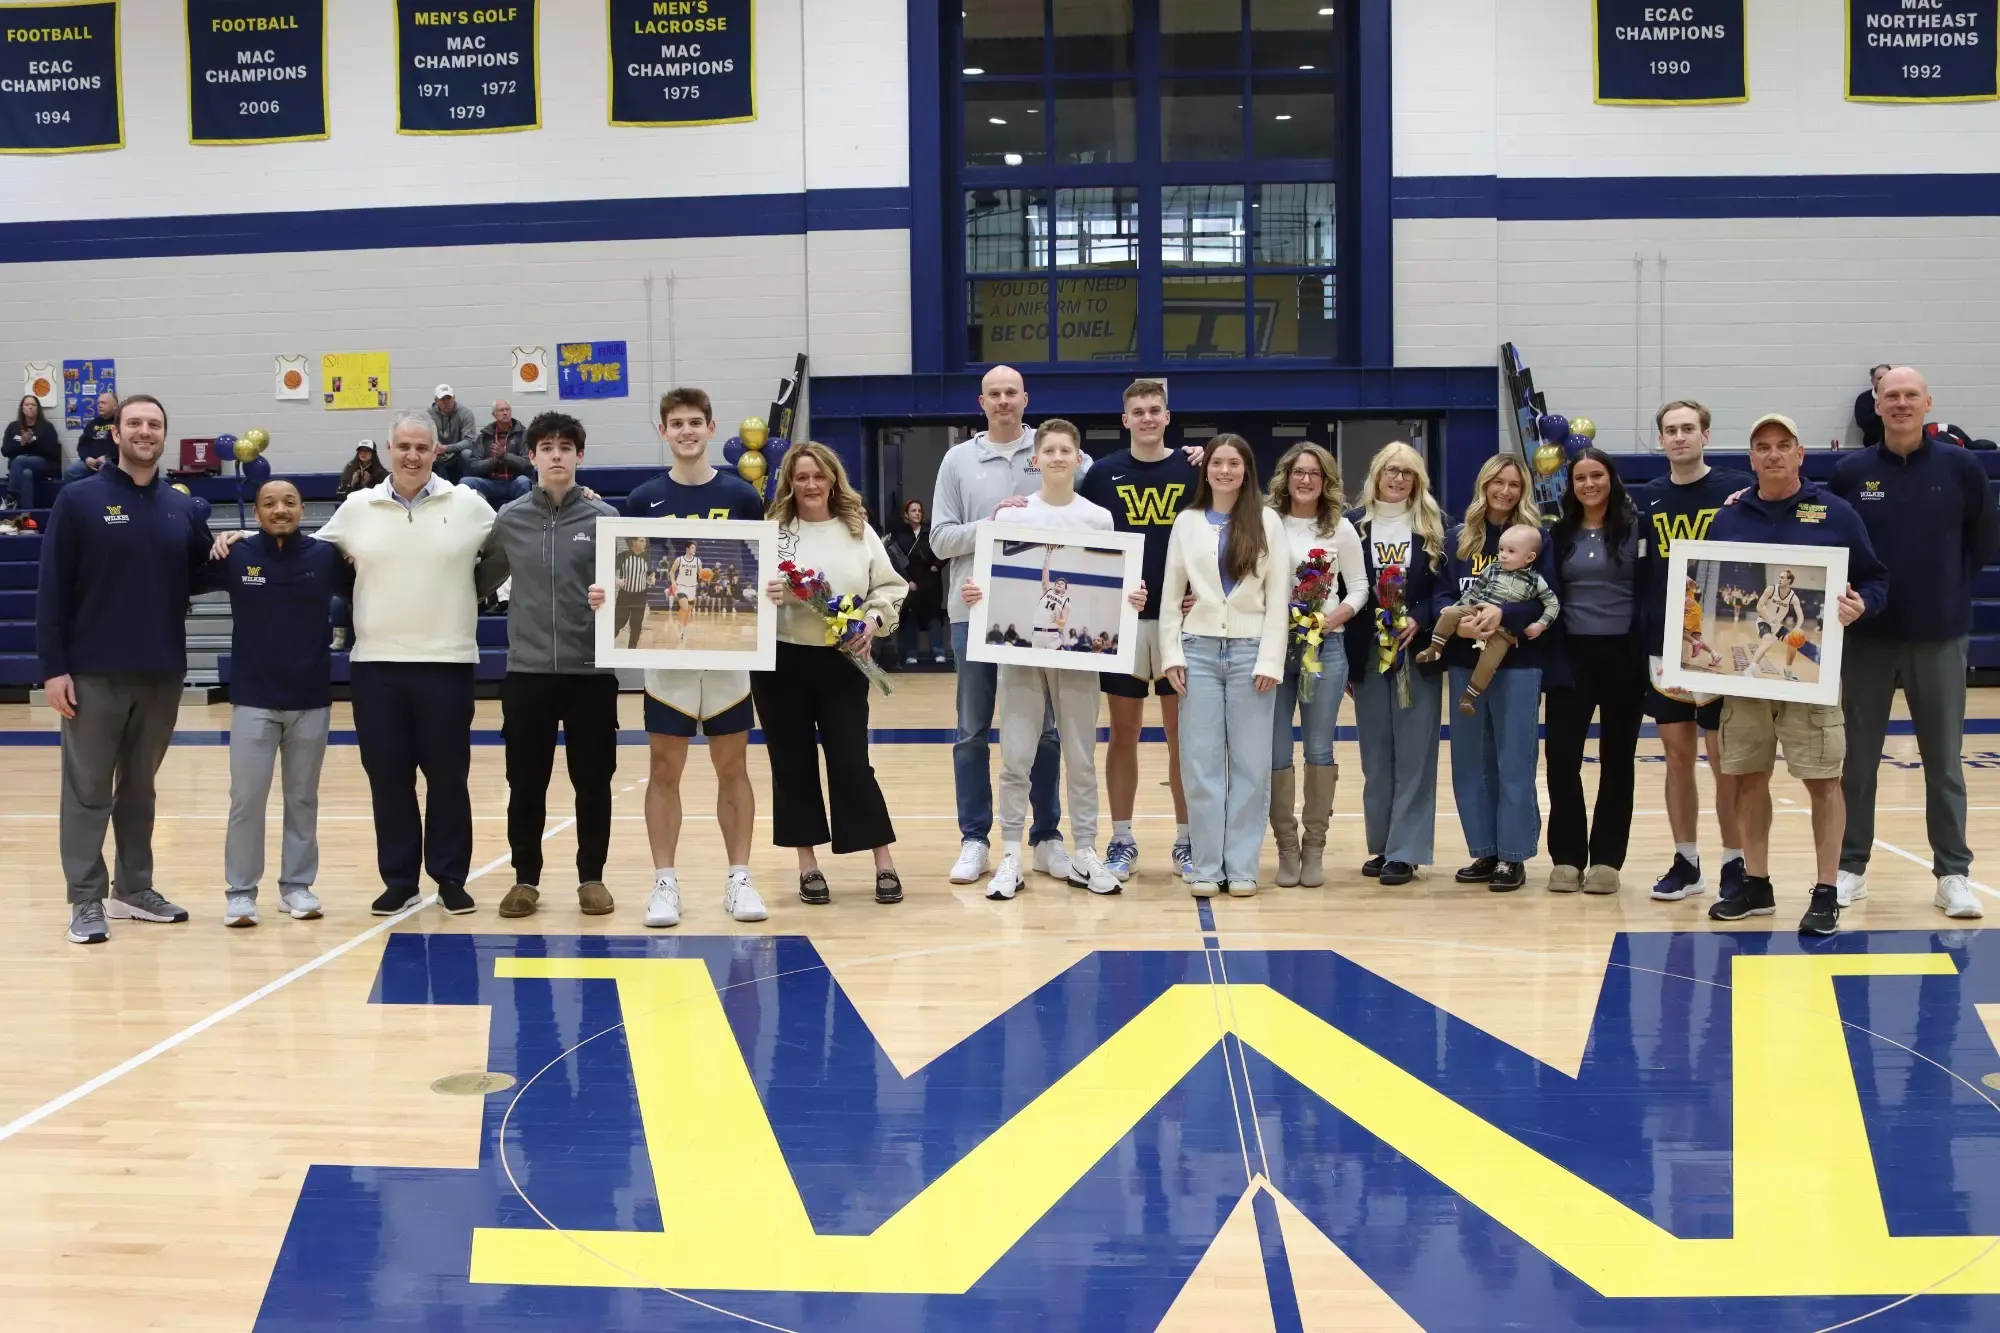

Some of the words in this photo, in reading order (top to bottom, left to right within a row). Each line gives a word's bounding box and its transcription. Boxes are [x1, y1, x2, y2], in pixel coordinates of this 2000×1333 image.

[653, 1, 708, 15] MEN'S
[1901, 0, 1943, 10] MAC
[415, 10, 468, 25] MEN'S
[473, 8, 517, 23] GOLF
[1644, 8, 1694, 22] ECAC
[1866, 13, 1978, 28] NORTHEAST
[212, 16, 298, 32] FOOTBALL
[634, 18, 727, 34] LACROSSE
[7, 26, 93, 42] FOOTBALL
[1615, 25, 1725, 41] CHAMPIONS
[1867, 32, 1979, 48] CHAMPIONS
[447, 36, 485, 51] MAC
[661, 44, 701, 58] MAC
[237, 50, 275, 65] MAC
[414, 52, 519, 69] CHAMPIONS
[29, 60, 73, 75] ECAC
[206, 66, 307, 83] CHAMPIONS
[627, 59, 734, 77] CHAMPIONS
[1649, 61, 1690, 75] 1990
[1901, 65, 1942, 79] 1992
[1, 76, 101, 93] CHAMPIONS
[418, 84, 449, 97] 1971
[481, 81, 516, 95] 1972
[663, 86, 700, 100] 1975
[239, 101, 280, 115] 2006
[449, 106, 485, 119] 1979
[35, 111, 71, 124] 1994
[992, 282, 1023, 297] YOU
[1084, 278, 1126, 293] NEED
[990, 304, 1000, 318] A
[1087, 298, 1108, 313] TO
[991, 324, 1016, 342] BE
[1021, 319, 1115, 341] COONEL
[1116, 483, 1186, 526] W
[1373, 541, 1410, 564] W
[684, 568, 693, 577] 21
[1045, 600, 1056, 611] 14
